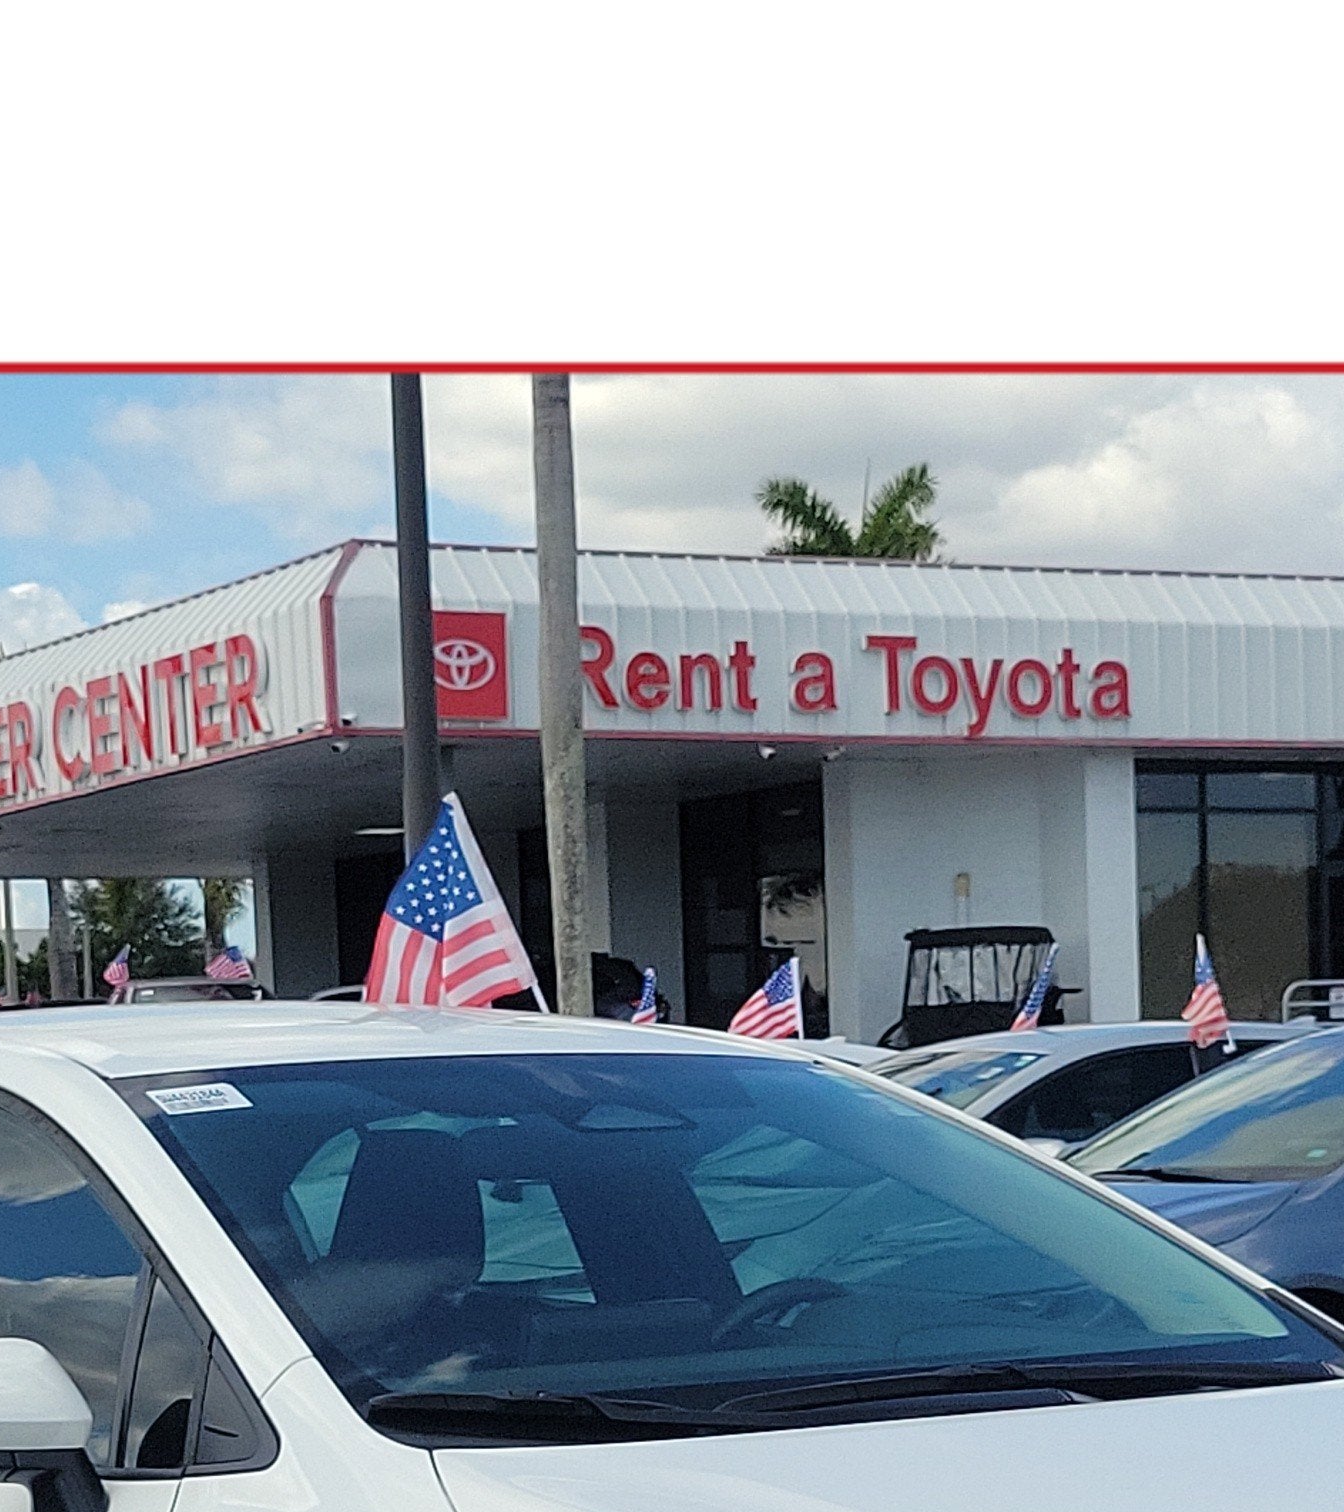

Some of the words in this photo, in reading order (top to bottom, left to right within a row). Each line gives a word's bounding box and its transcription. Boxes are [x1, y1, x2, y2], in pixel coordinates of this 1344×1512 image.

[55, 633, 265, 782] CENTER
[579, 625, 758, 711] Rent
[793, 652, 838, 712] a
[865, 635, 1132, 738] Toyota
